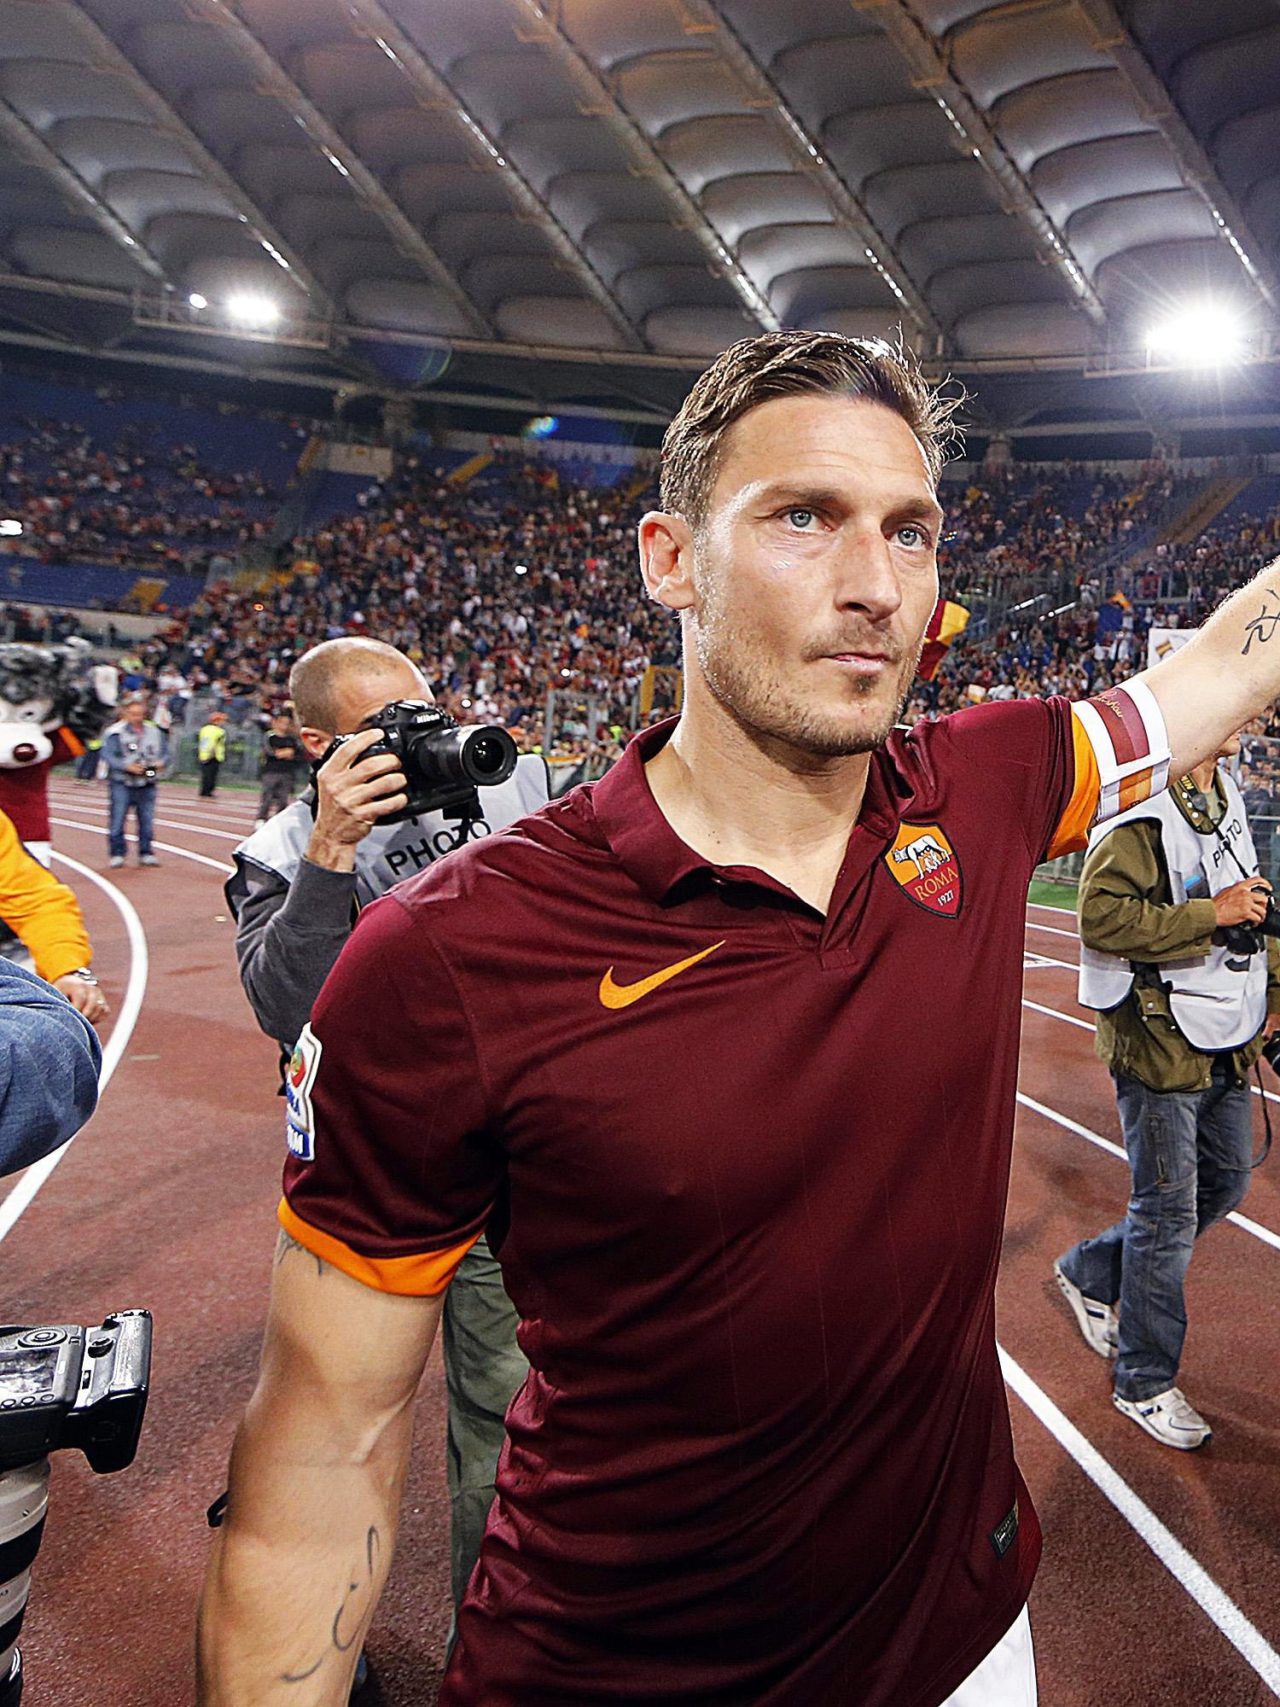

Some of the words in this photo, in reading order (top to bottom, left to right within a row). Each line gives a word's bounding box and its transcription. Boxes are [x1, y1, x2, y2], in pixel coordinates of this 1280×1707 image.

[385, 819, 491, 875] PHOTO
[914, 867, 958, 901] ROMA
[937, 889, 954, 907] 1927
